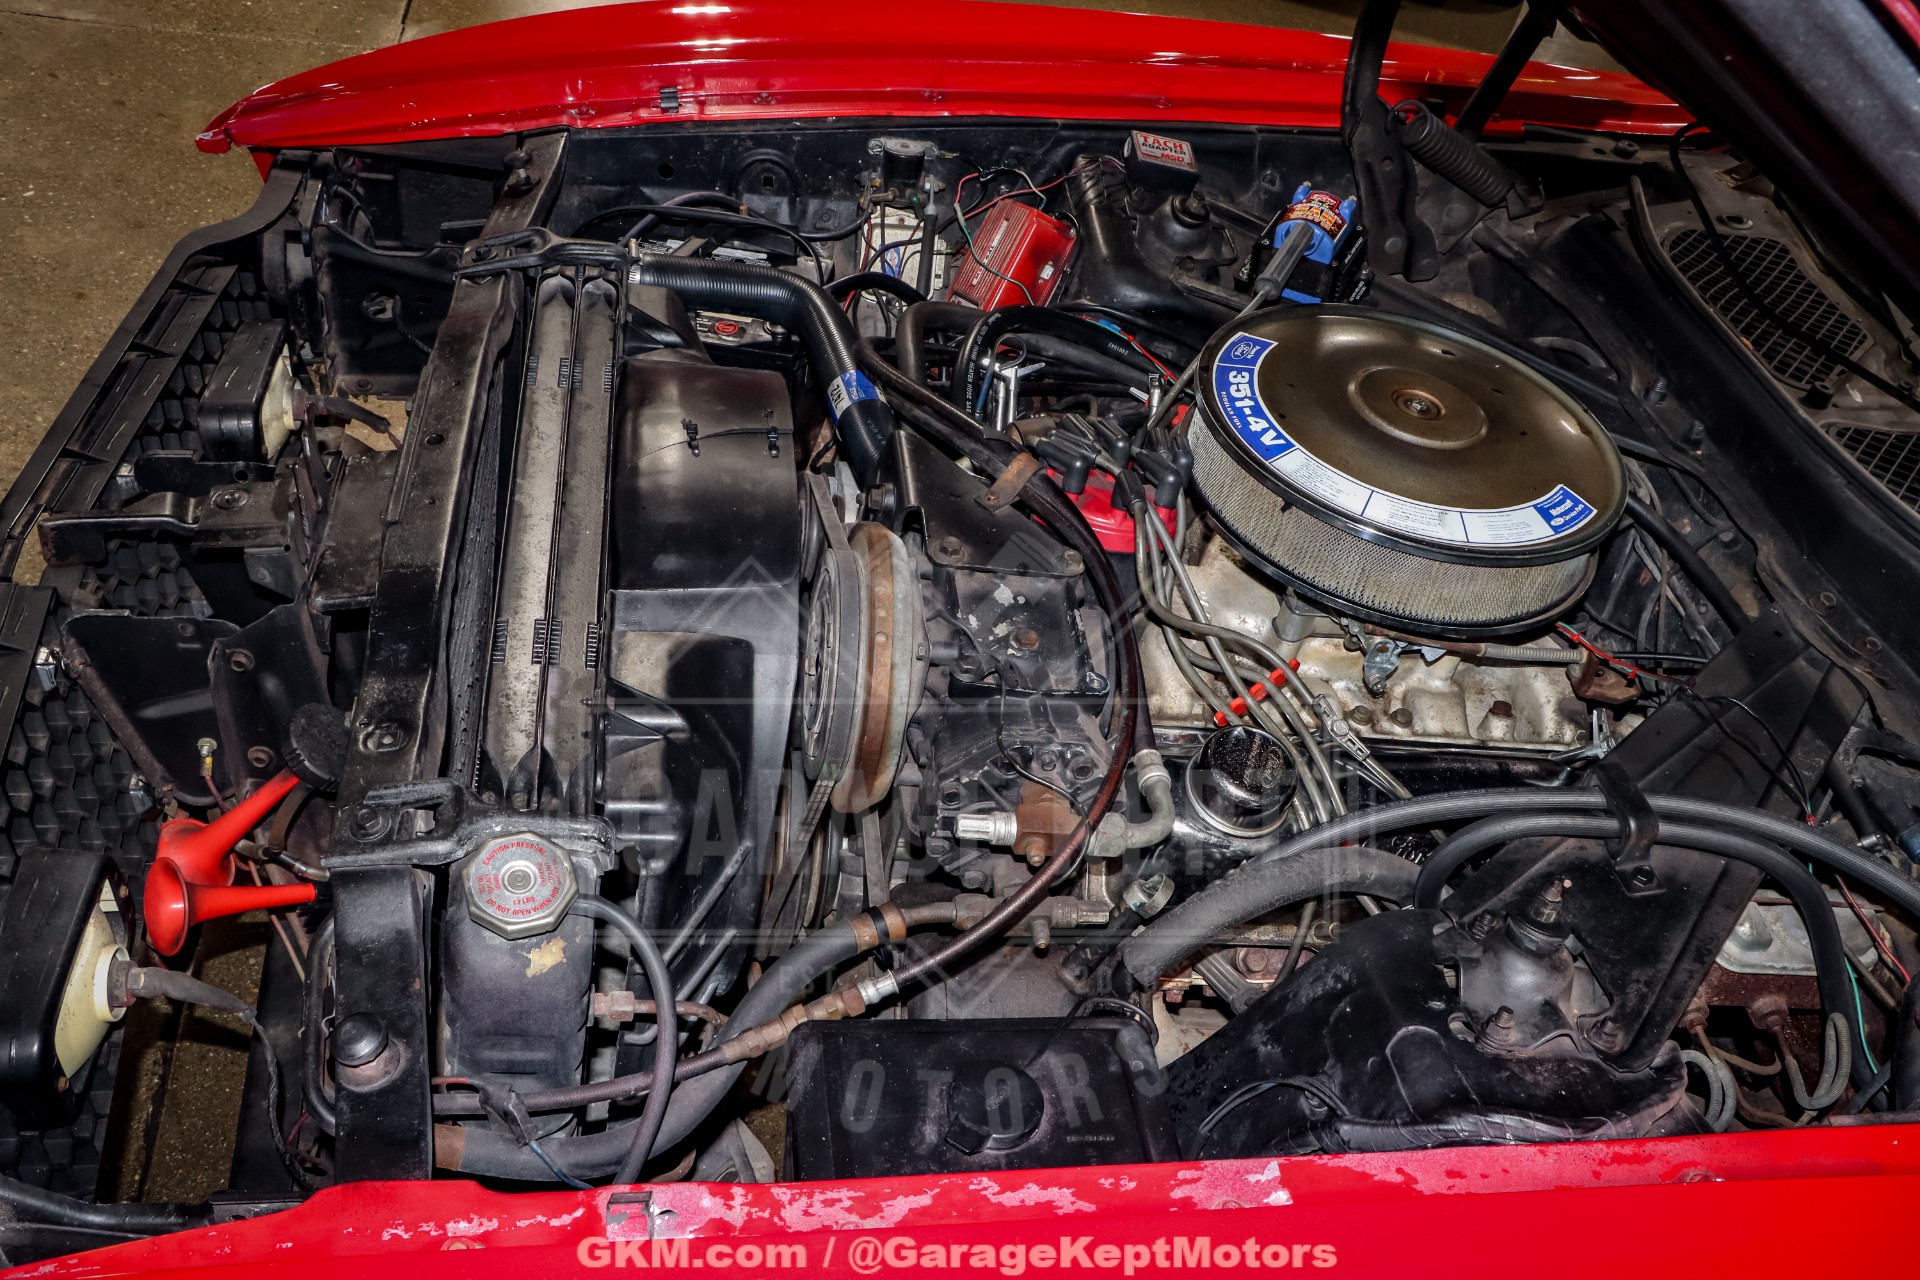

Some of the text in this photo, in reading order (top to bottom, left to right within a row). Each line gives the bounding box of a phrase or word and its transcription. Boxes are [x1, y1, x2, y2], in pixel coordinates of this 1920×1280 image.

[1141, 135, 1184, 150] TACH
[1141, 142, 1187, 156] ADAPTER
[1160, 152, 1185, 162] MSD
[967, 361, 975, 382] HEATER
[1220, 391, 1243, 429] REGULAR FUEL
[1228, 370, 1287, 446] 351-4V
[482, 844, 510, 866] CAUTION
[486, 898, 497, 907] DO
[495, 904, 511, 915] NOT
[532, 898, 553, 913] WHEN
[550, 886, 561, 899] HOT
[512, 896, 537, 906] 13 LBS
